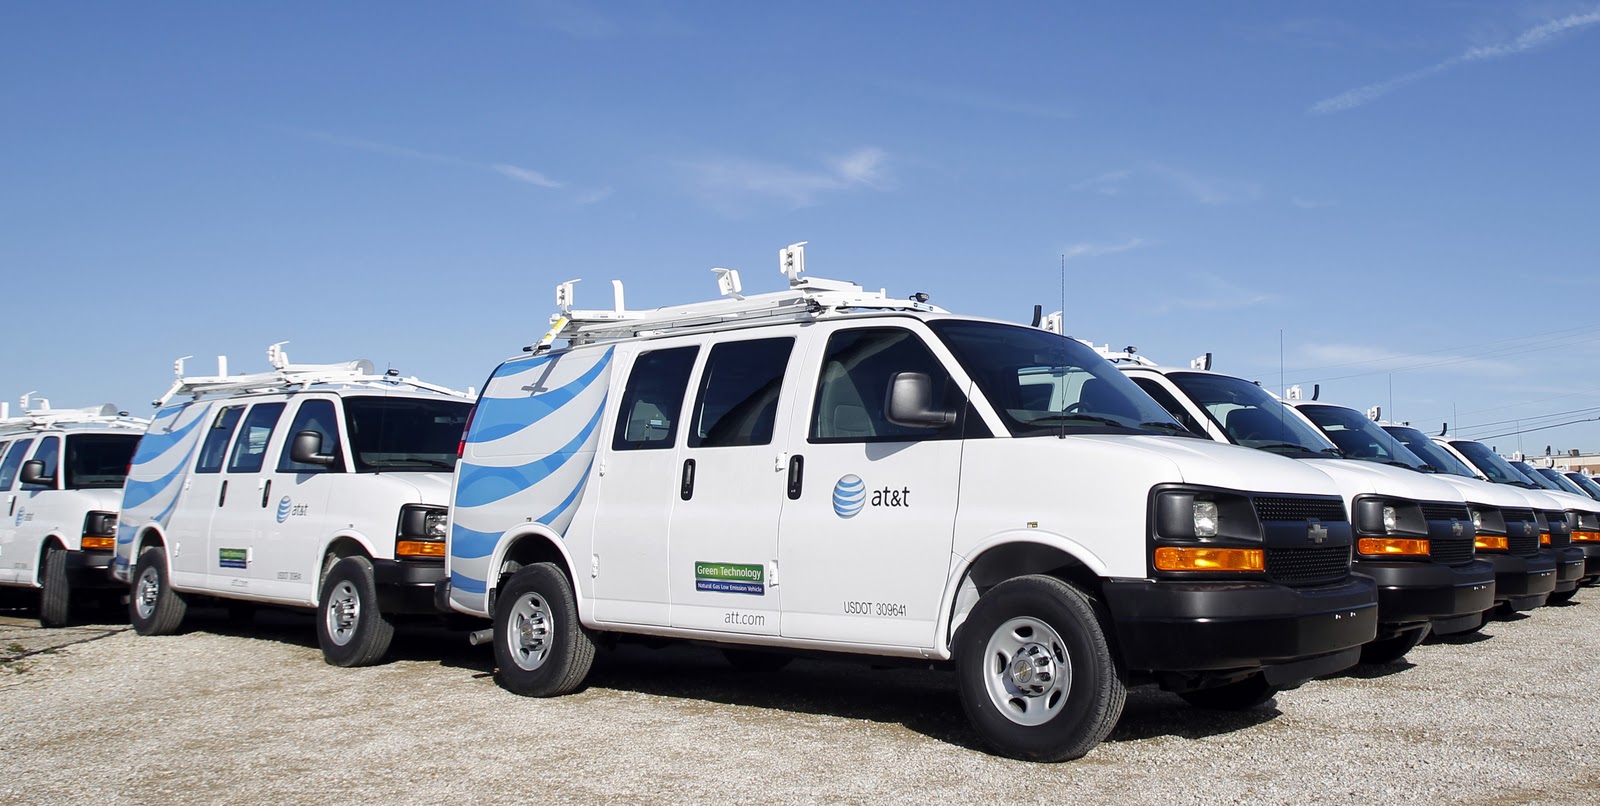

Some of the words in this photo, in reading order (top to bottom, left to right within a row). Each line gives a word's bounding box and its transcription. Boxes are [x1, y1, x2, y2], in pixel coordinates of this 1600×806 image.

[871, 486, 910, 507] at&t
[697, 565, 718, 576] Green
[720, 566, 762, 580] Technology
[844, 601, 872, 615] USDOT
[876, 602, 907, 617] 309641
[724, 611, 765, 626] att.com
